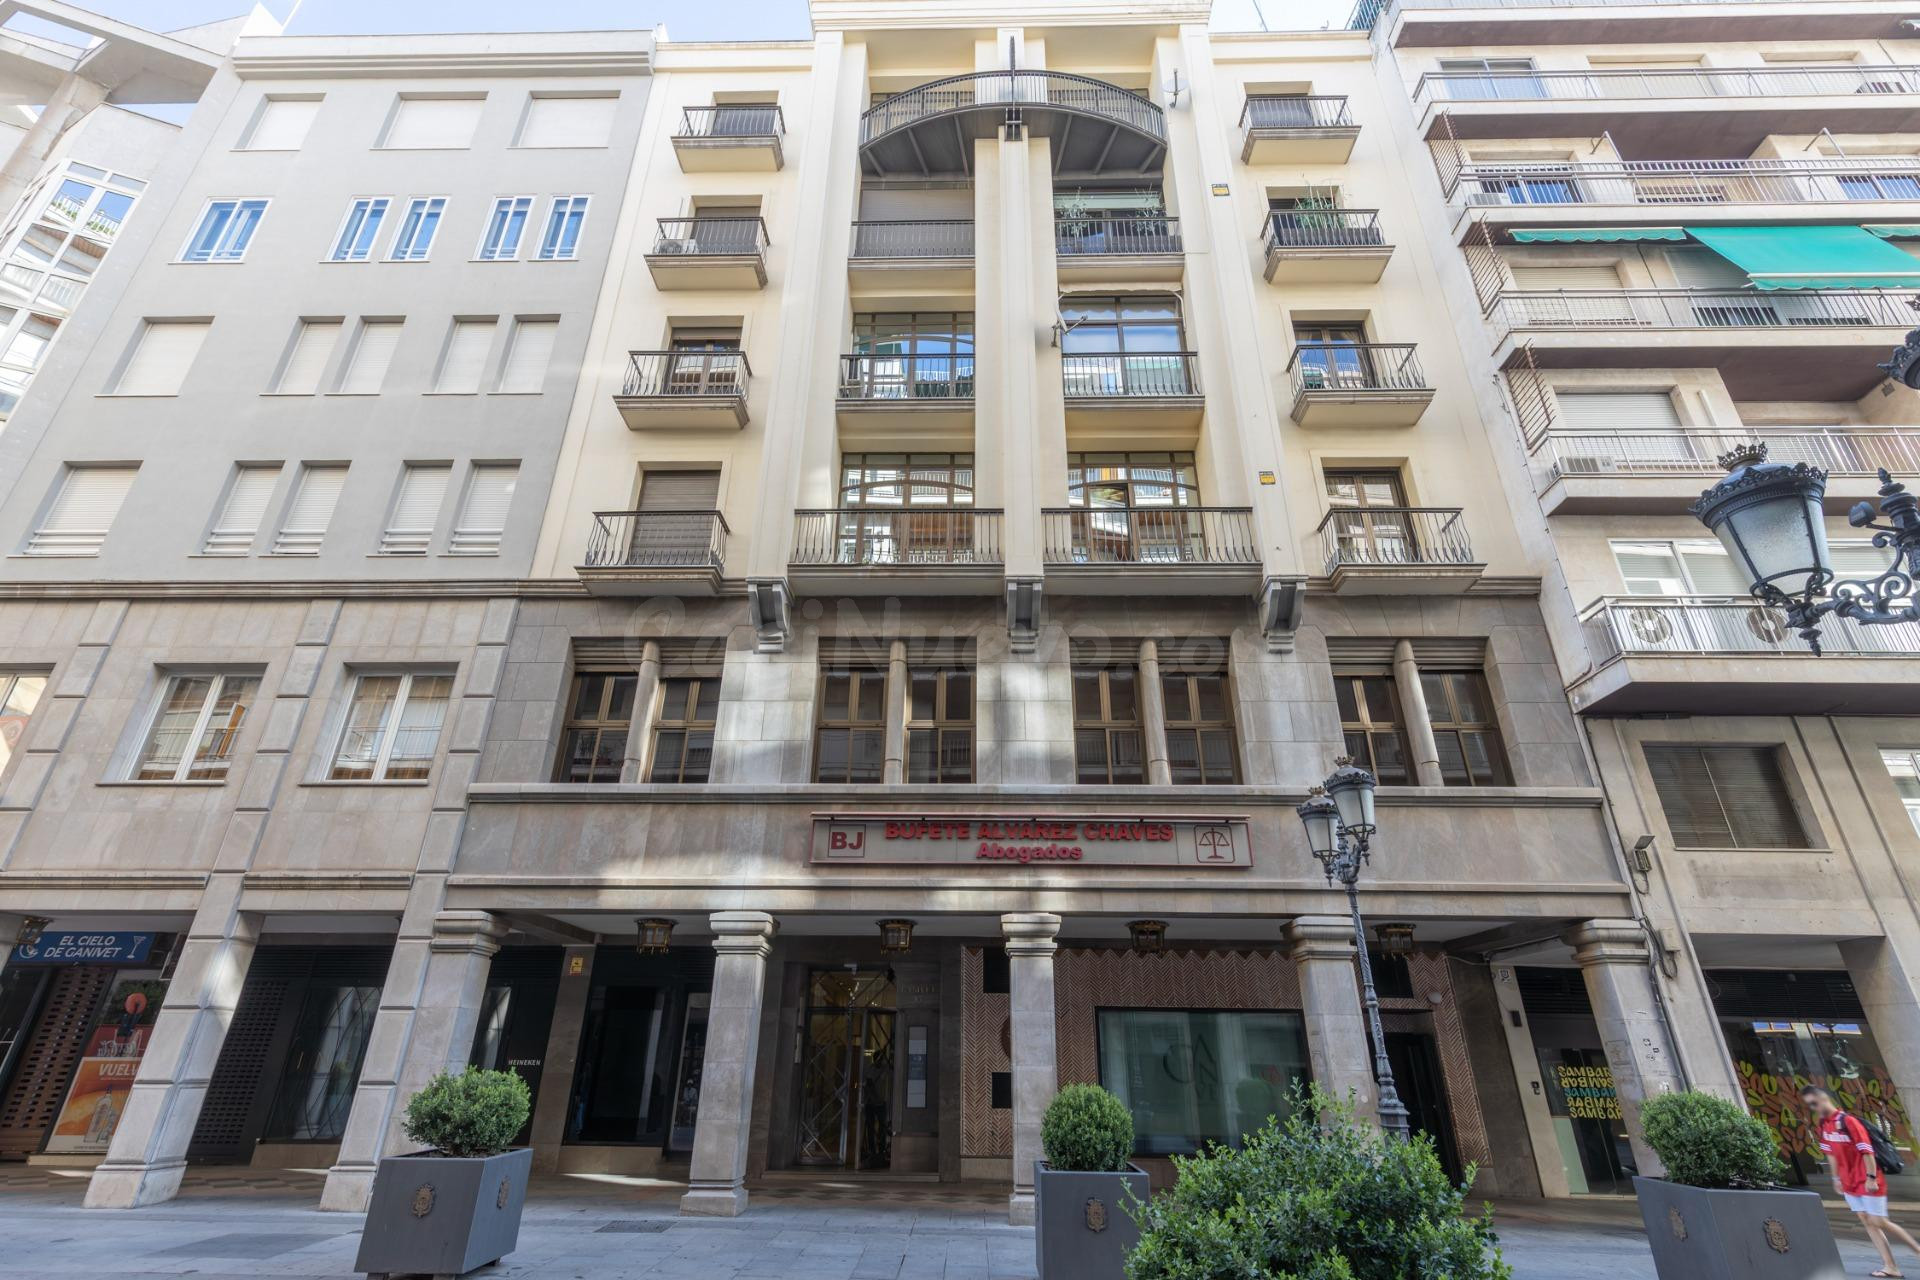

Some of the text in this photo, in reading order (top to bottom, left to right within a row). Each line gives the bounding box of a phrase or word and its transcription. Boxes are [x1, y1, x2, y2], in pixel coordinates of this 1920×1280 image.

[830, 831, 864, 850] BJ
[884, 822, 1174, 842] BUFETE ALVAREZ CHAVES
[975, 842, 1083, 863] Abogados
[59, 935, 116, 946] EL CIELO
[43, 947, 122, 958] DE GANIVET
